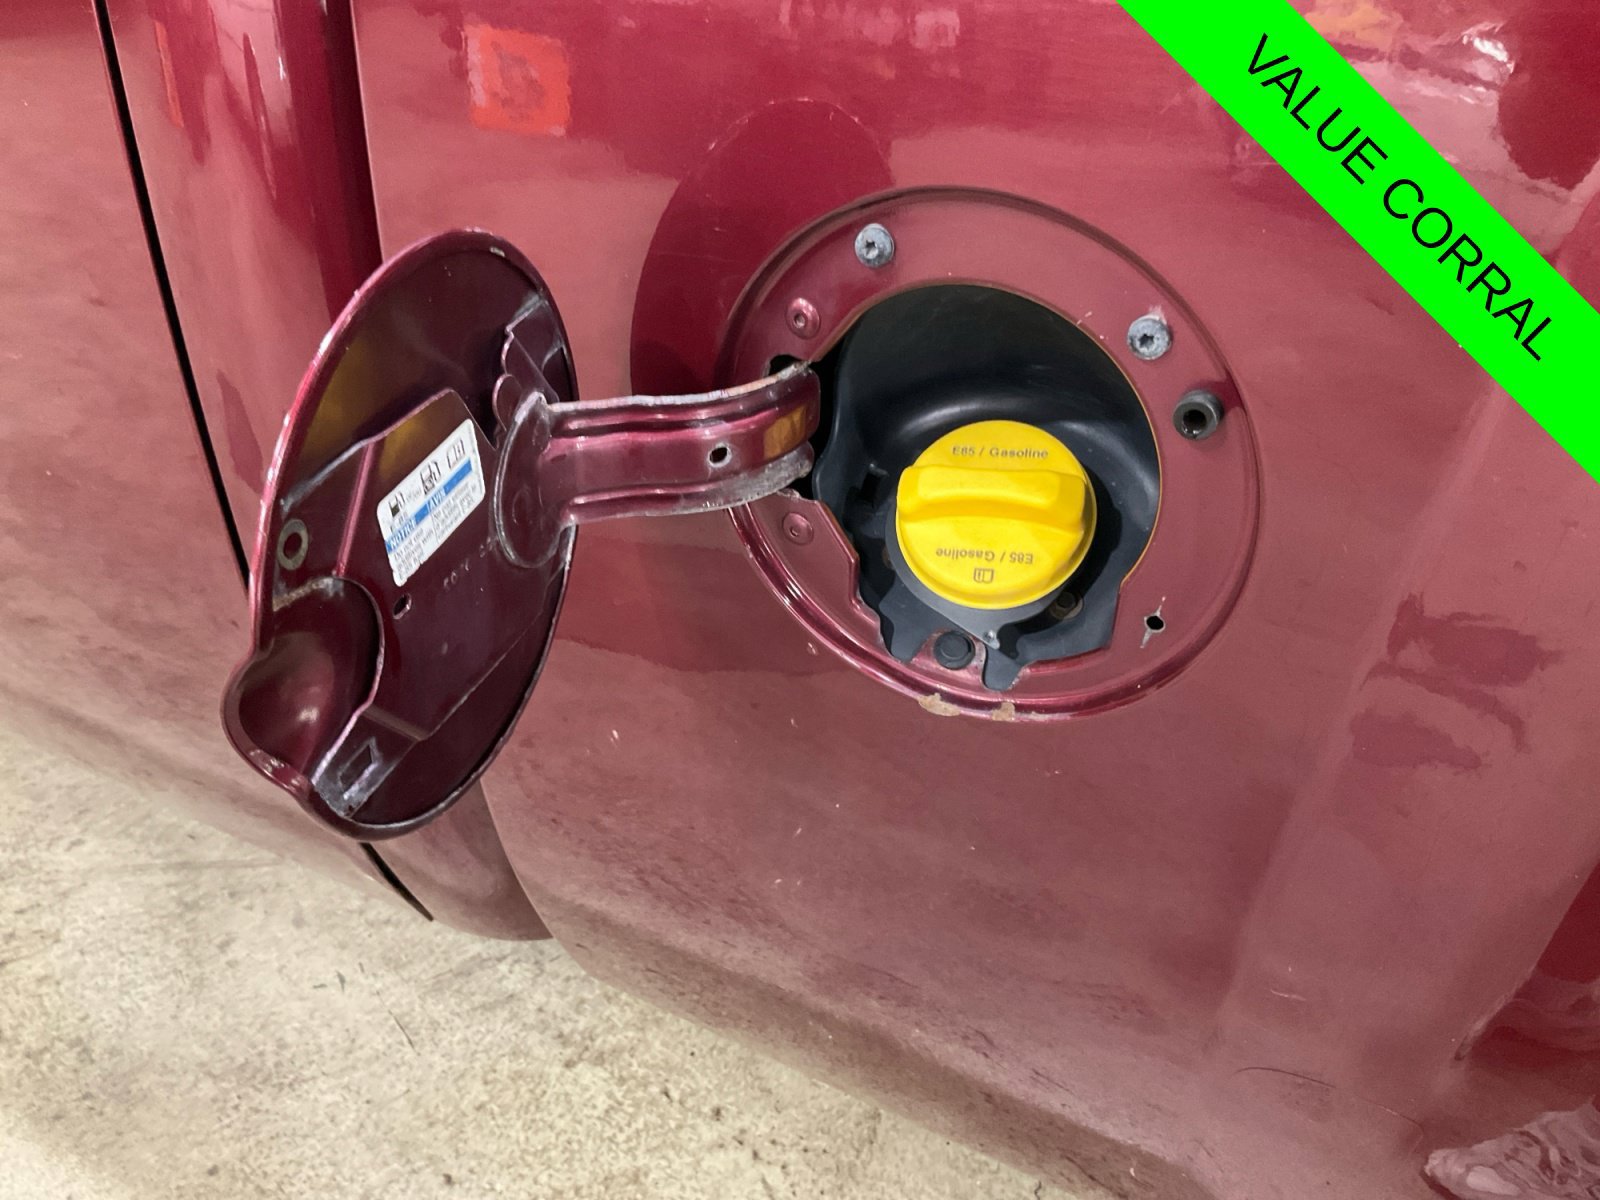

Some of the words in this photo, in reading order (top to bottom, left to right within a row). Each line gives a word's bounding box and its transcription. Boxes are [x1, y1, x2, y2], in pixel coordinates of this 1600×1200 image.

[952, 446, 975, 456] E85
[979, 446, 985, 457] /
[989, 447, 1049, 459] Gasoline
[390, 518, 415, 549] NOTICE
[936, 547, 995, 561] Gasoline
[1000, 552, 1006, 563] /
[1009, 552, 1034, 564] E85
